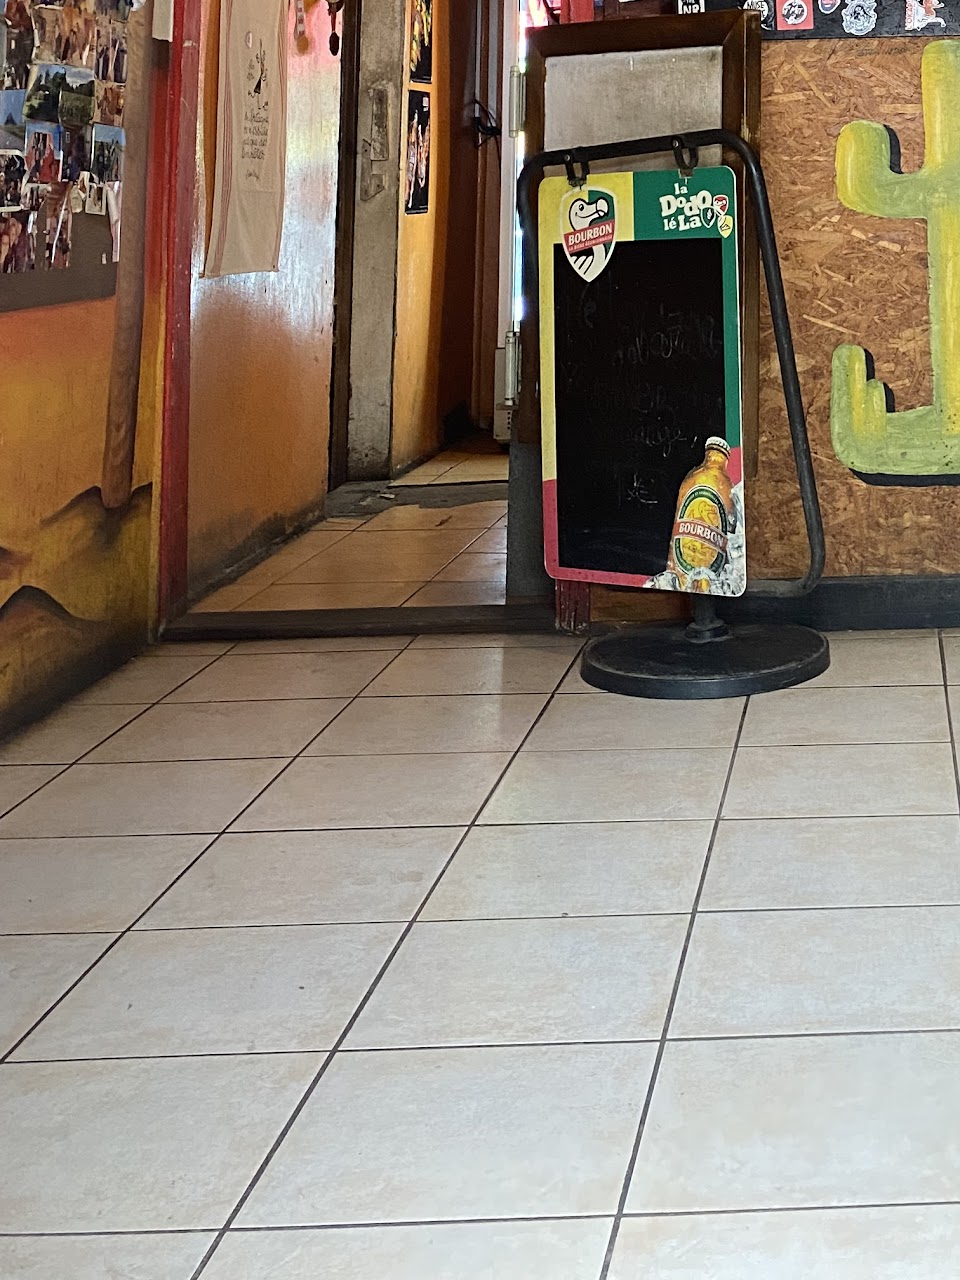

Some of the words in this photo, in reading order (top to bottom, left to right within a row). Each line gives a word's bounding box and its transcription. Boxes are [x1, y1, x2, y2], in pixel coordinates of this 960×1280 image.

[674, 182, 688, 195] la
[663, 217, 677, 231] lé
[568, 223, 613, 246] BOURBON
[678, 522, 725, 549] BOURBON
